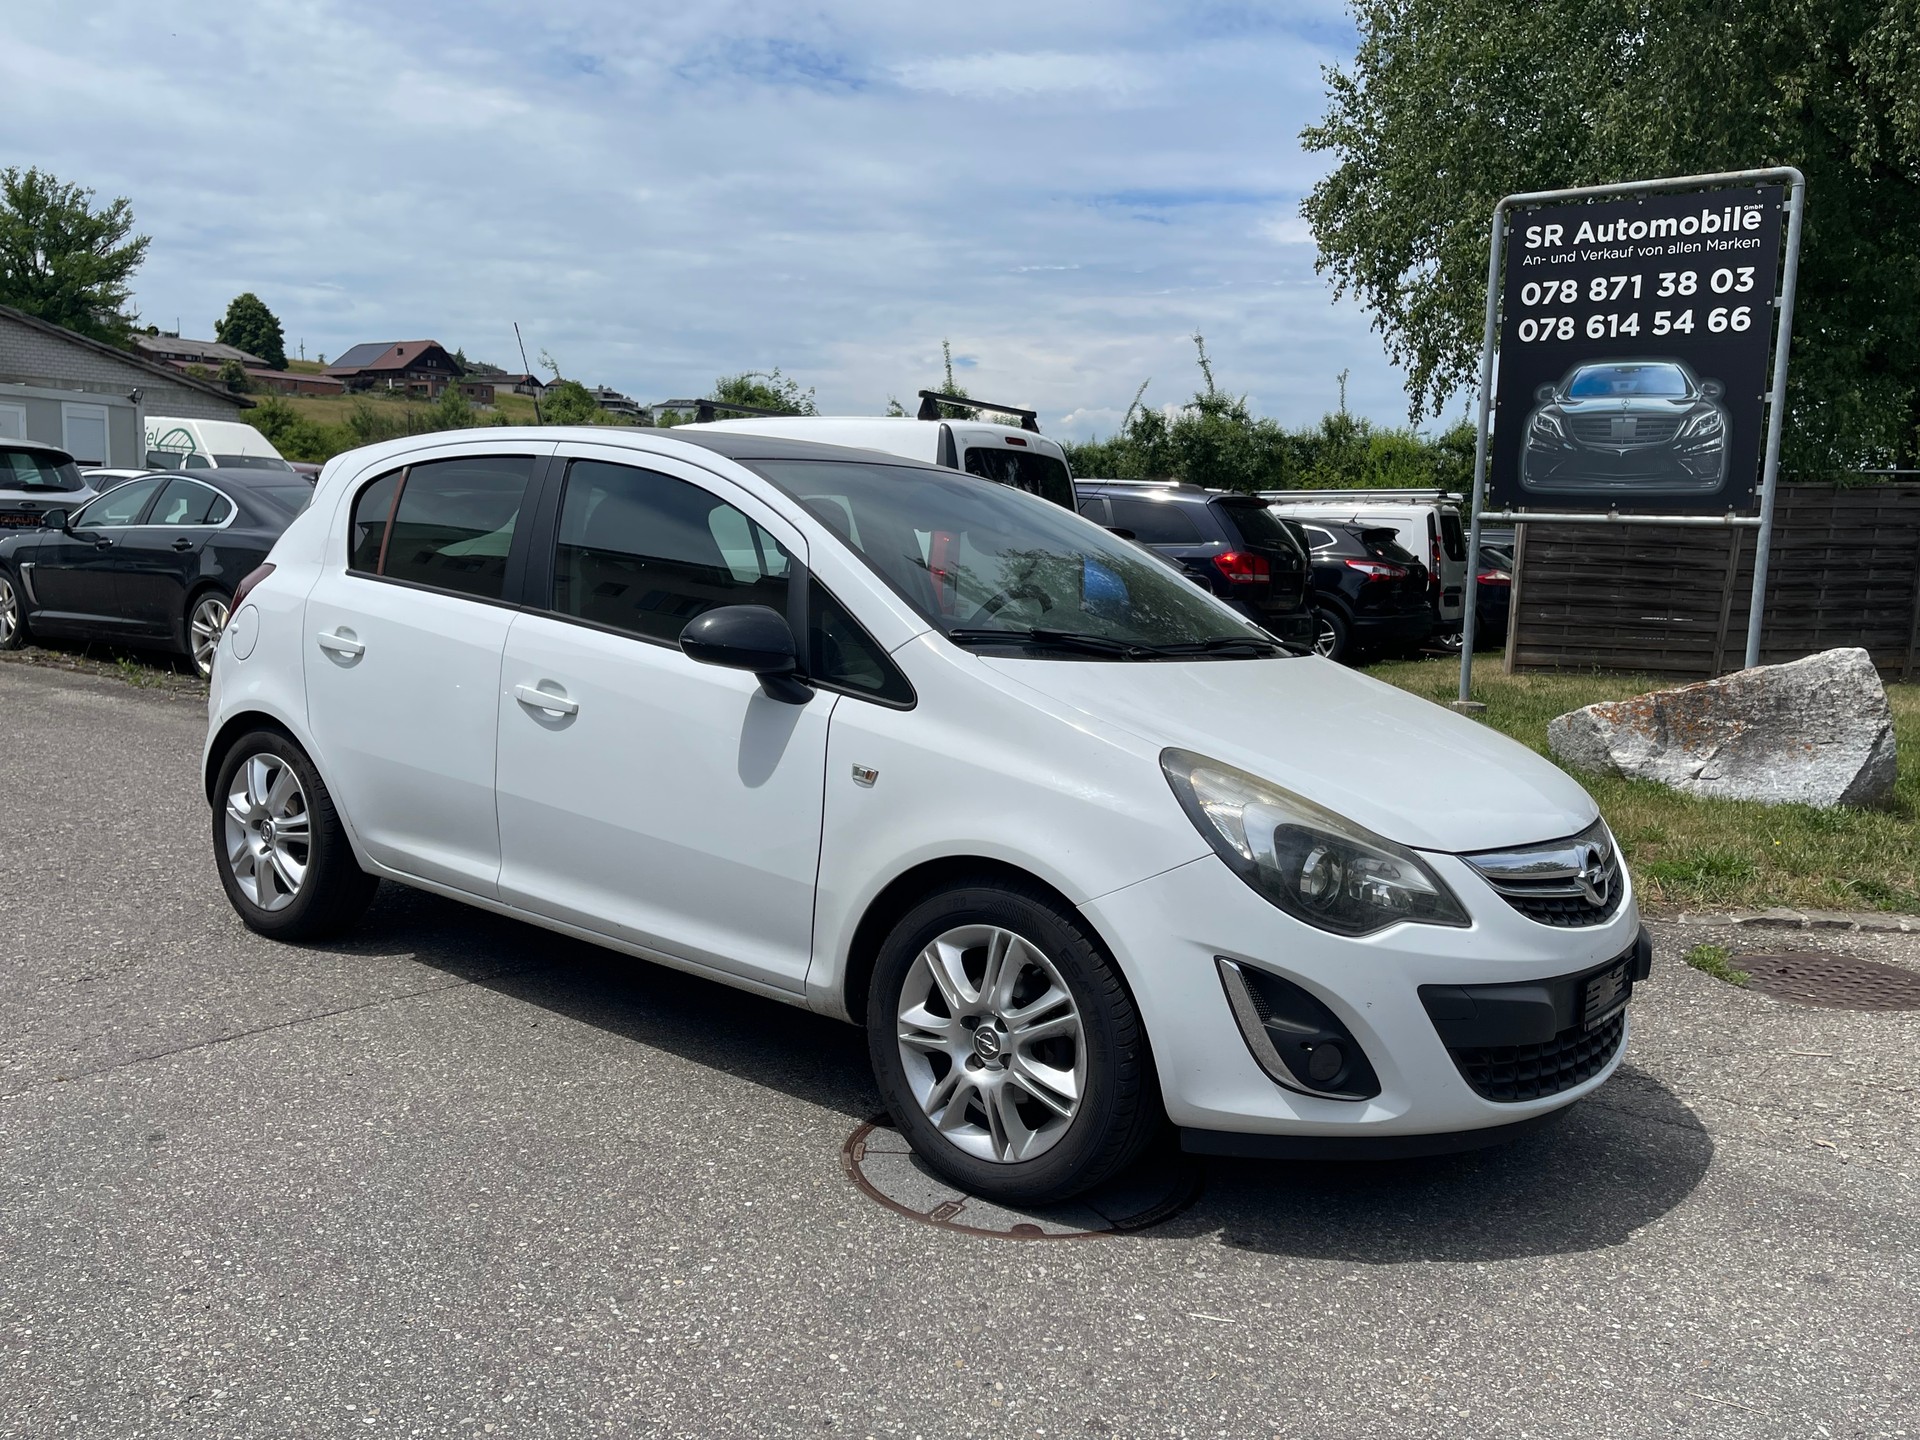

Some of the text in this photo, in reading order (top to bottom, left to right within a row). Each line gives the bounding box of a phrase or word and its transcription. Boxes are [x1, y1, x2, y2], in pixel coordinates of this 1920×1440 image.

[1524, 203, 1764, 249] SR Automobile GmbH
[1522, 236, 1761, 266] An- und Verkauf von allen Marken
[1520, 266, 1755, 306] 078 871 38 03
[1518, 305, 1752, 343] 078 614 54 66
